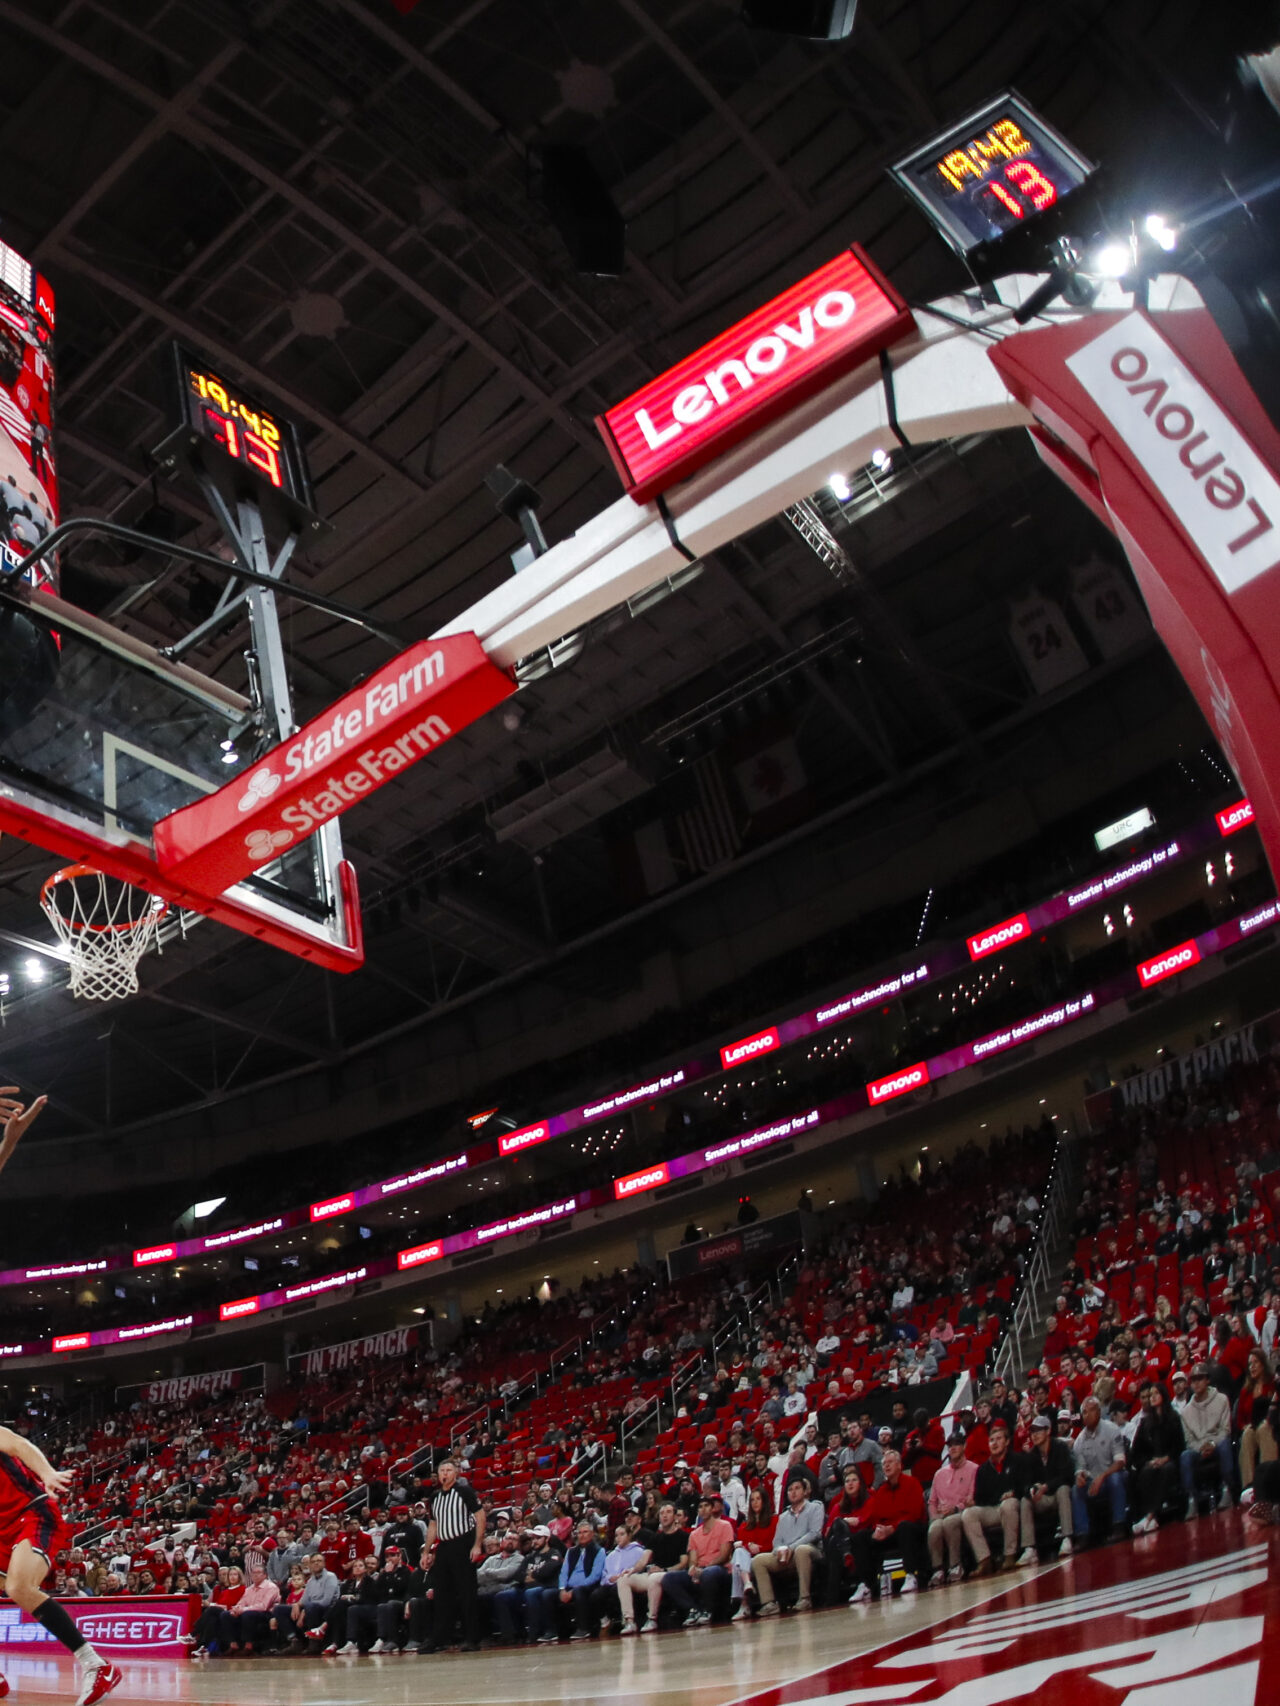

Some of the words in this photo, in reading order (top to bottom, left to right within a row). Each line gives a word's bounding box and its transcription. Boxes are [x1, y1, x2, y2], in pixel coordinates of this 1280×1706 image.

[937, 118, 1031, 192] 19:42
[989, 160, 1057, 219] 13
[634, 290, 856, 450] Lenovo
[198, 375, 280, 451] 19:42
[1109, 346, 1274, 554] Lenovo
[1027, 623, 1061, 660] 24
[1068, 882, 1103, 906] Smarter
[1103, 858, 1152, 888] technology
[1152, 850, 1166, 864] for
[1167, 843, 1178, 856] all
[1240, 903, 1278, 931] Smarter
[972, 923, 1023, 953] Lenovo
[1142, 949, 1192, 980] Lenovo
[816, 1001, 851, 1022] Smarter
[851, 979, 900, 1007] technology
[901, 972, 915, 985] for
[916, 965, 928, 978] all
[973, 1032, 1011, 1055] Smarter
[1012, 1008, 1064, 1039] technology
[1065, 1002, 1080, 1015] for
[1081, 994, 1094, 1008] all
[725, 1036, 773, 1062] Lenovo
[583, 1100, 615, 1118] Smarter
[614, 1082, 659, 1106] technology
[658, 1076, 672, 1088] for
[673, 1070, 684, 1082] all
[872, 1071, 922, 1098] Lenovo
[502, 1128, 544, 1150] Lenovo
[705, 1142, 740, 1161] Smarter
[740, 1122, 791, 1148] technology
[791, 1117, 806, 1129] for
[807, 1110, 818, 1123] all
[381, 1178, 408, 1193] Smarter
[407, 1164, 446, 1184] technology
[445, 1160, 457, 1170] for
[456, 1155, 467, 1166] all
[618, 1170, 664, 1194] Lenovo
[314, 1199, 351, 1217] Lenovo
[477, 1224, 508, 1239] Smarter
[507, 1209, 552, 1230] technology
[552, 1204, 564, 1215] for
[565, 1199, 576, 1211] all
[204, 1236, 230, 1247] Smarter
[229, 1226, 264, 1241] technology
[263, 1222, 274, 1231] for
[273, 1219, 282, 1228] all
[136, 1248, 173, 1262] Lenovo
[401, 1246, 439, 1265] Lenovo
[700, 1242, 737, 1260] Lenovo
[26, 1269, 52, 1278] Smarter
[50, 1264, 87, 1275] technology
[86, 1262, 98, 1270] for
[96, 1260, 106, 1269] all
[286, 1286, 311, 1298] Smarter
[310, 1275, 346, 1291] technology
[345, 1272, 357, 1280] for
[356, 1268, 366, 1278] all
[222, 1302, 256, 1316] Lenovo
[55, 1337, 87, 1348] Lenovo
[307, 1351, 324, 1376] IN
[328, 1341, 359, 1369] THE
[363, 1329, 410, 1360] PACK
[148, 1371, 232, 1402] STRENGTH
[82, 1621, 174, 1639] SHEETZ
